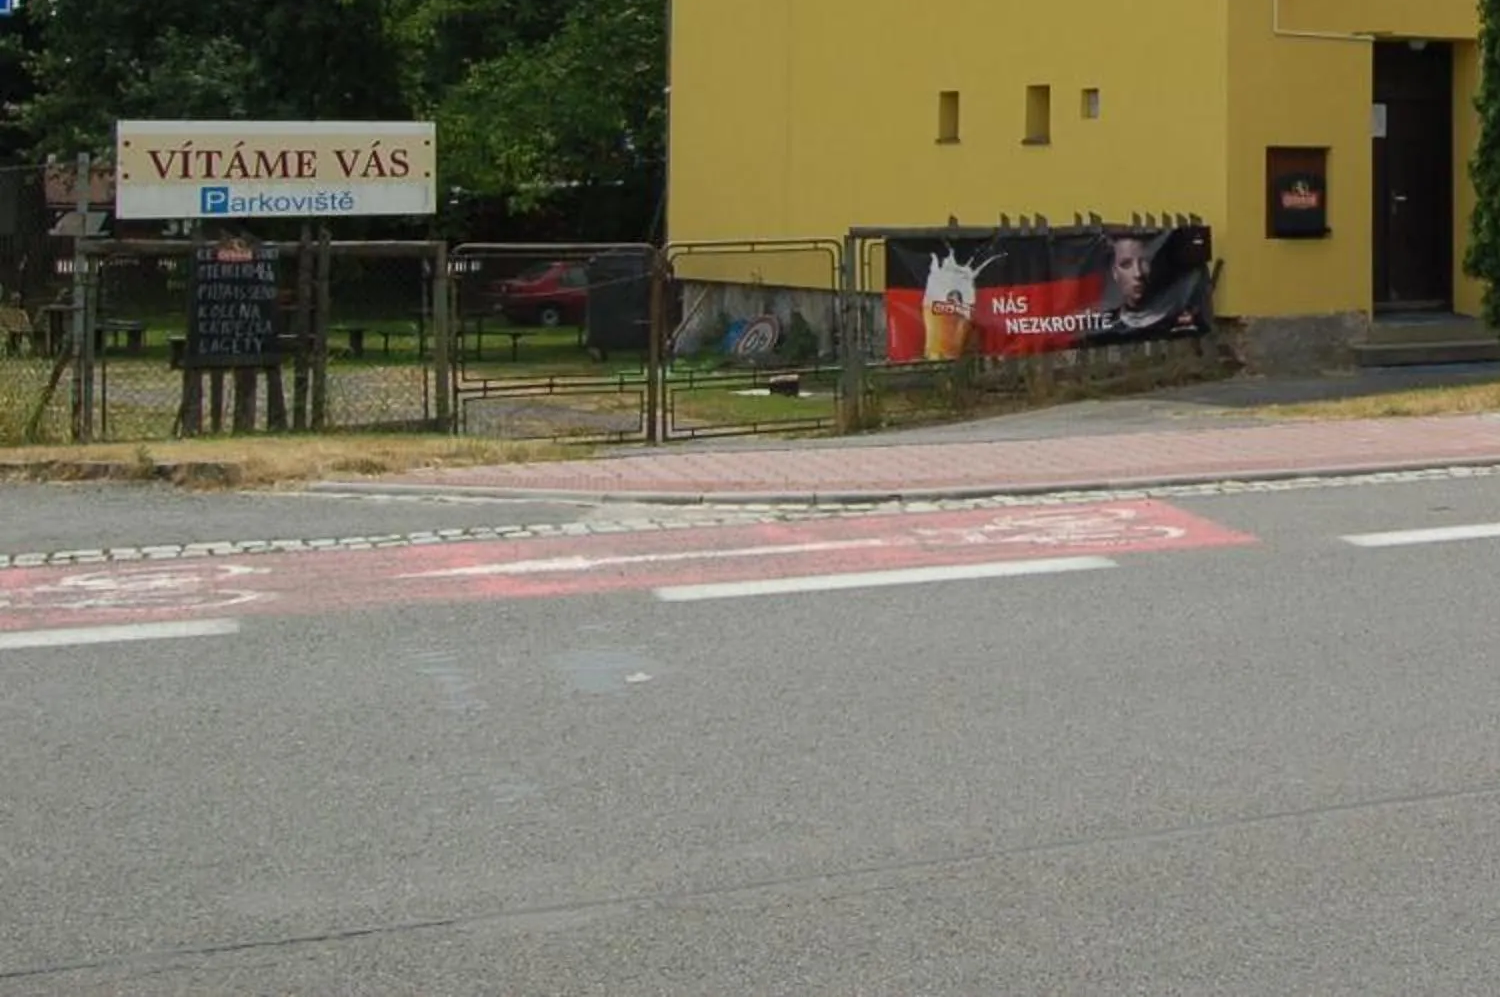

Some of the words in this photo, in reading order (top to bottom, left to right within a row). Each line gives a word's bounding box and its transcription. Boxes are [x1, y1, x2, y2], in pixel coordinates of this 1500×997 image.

[148, 141, 317, 179] VÍTÁME
[334, 141, 410, 178] VÁS
[204, 189, 355, 213] Parkoviště
[992, 290, 1028, 315] NÁS
[1005, 307, 1114, 334] NEZKROTÍTE
